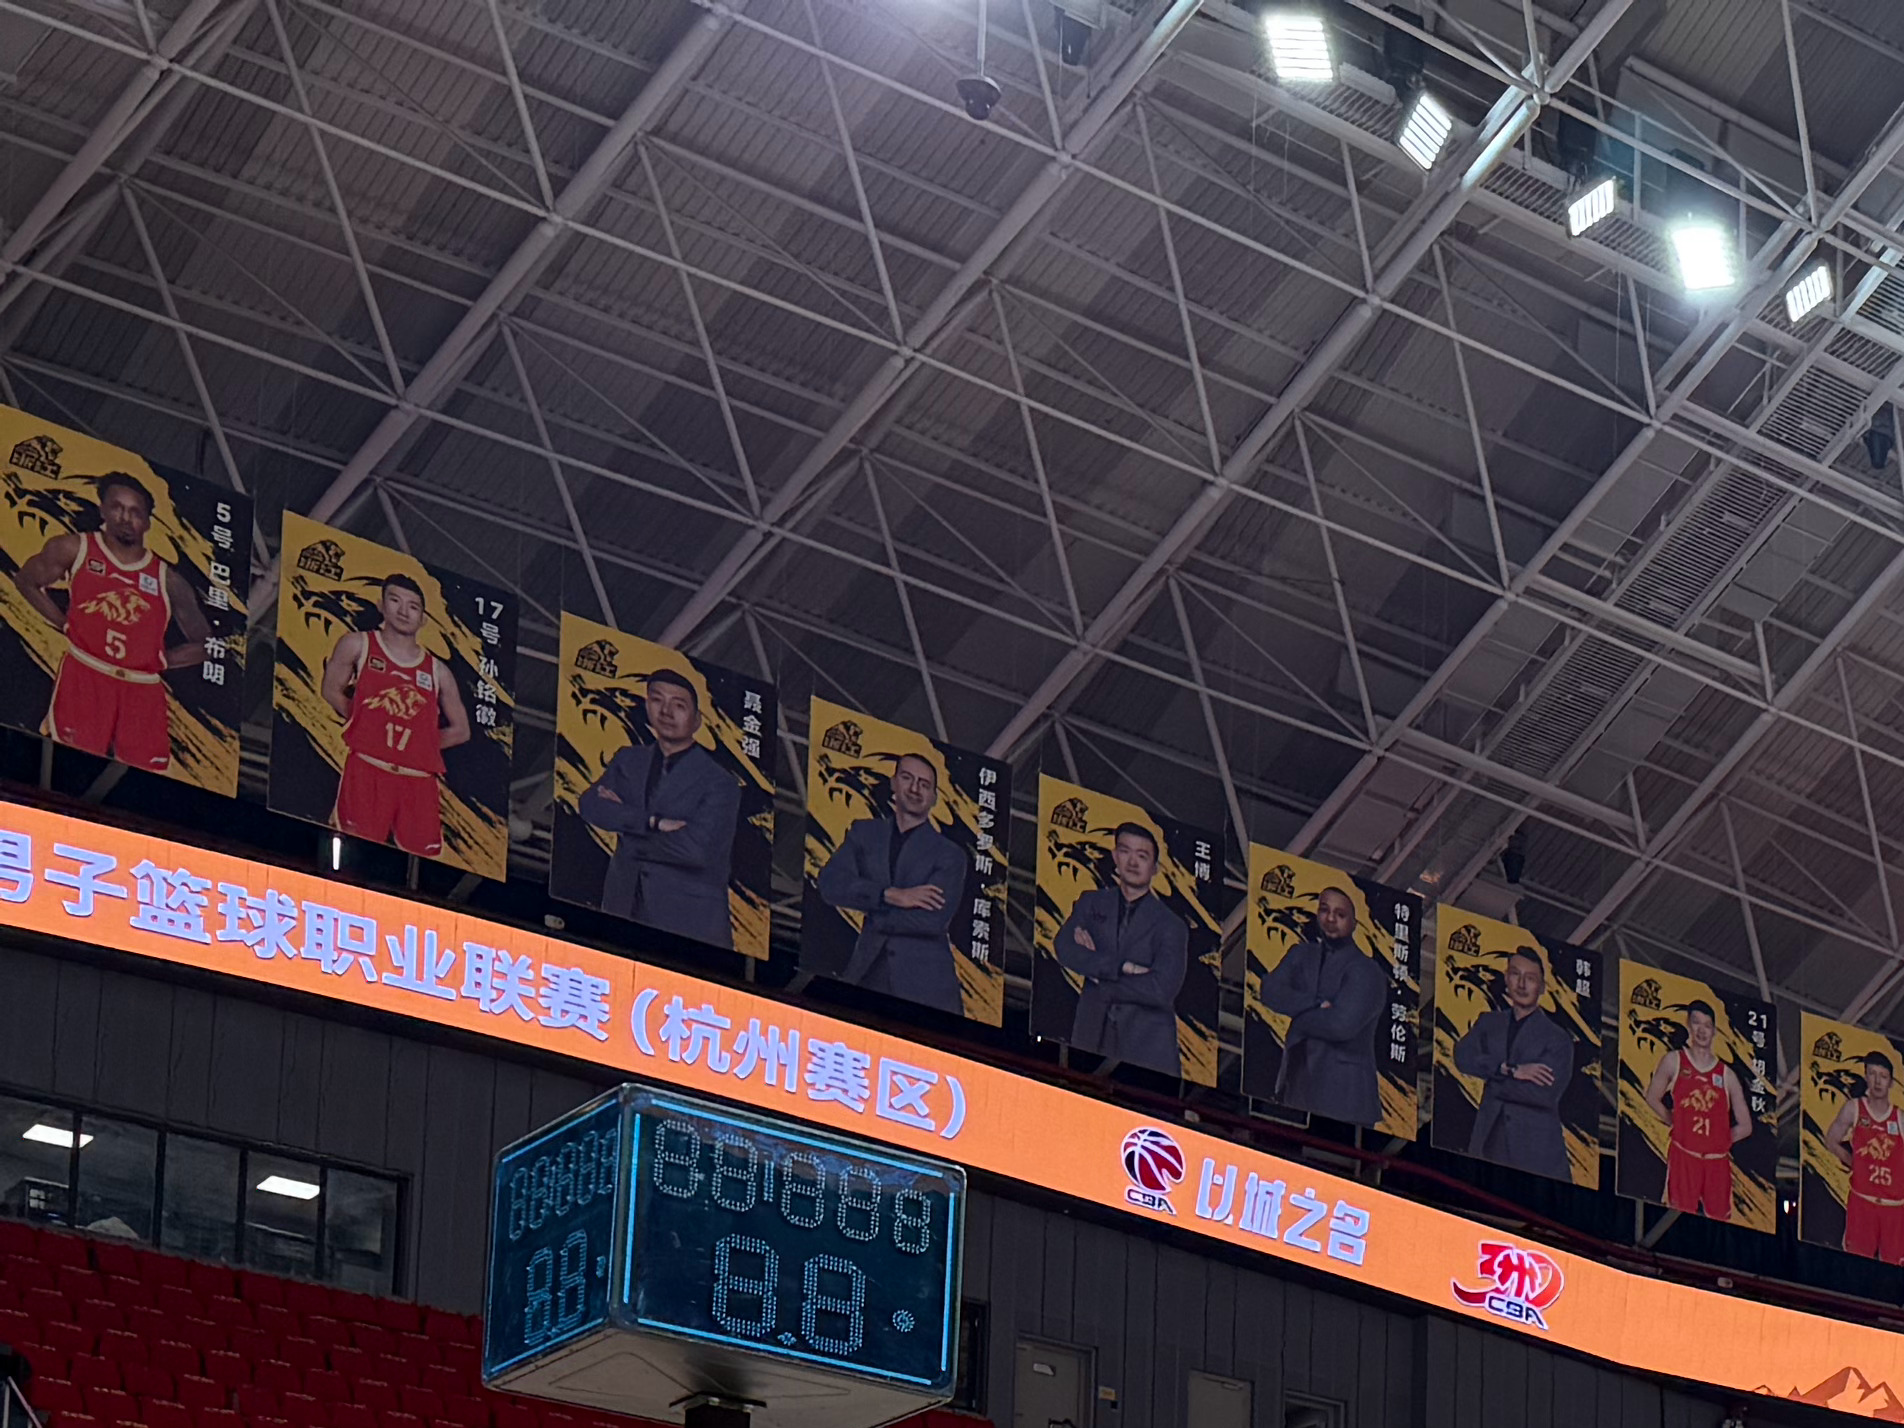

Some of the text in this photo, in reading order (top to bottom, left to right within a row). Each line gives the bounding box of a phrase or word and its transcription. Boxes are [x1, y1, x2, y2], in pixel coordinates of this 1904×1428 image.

[475, 597, 504, 645] 17号
[105, 629, 127, 659] 5
[385, 722, 412, 751] 17
[1692, 1115, 1712, 1136] 21
[1868, 1163, 1892, 1187] 25
[1126, 1185, 1179, 1215] CBA
[1196, 1156, 1371, 1267] 以城之名
[1485, 1293, 1549, 1330] CBA
